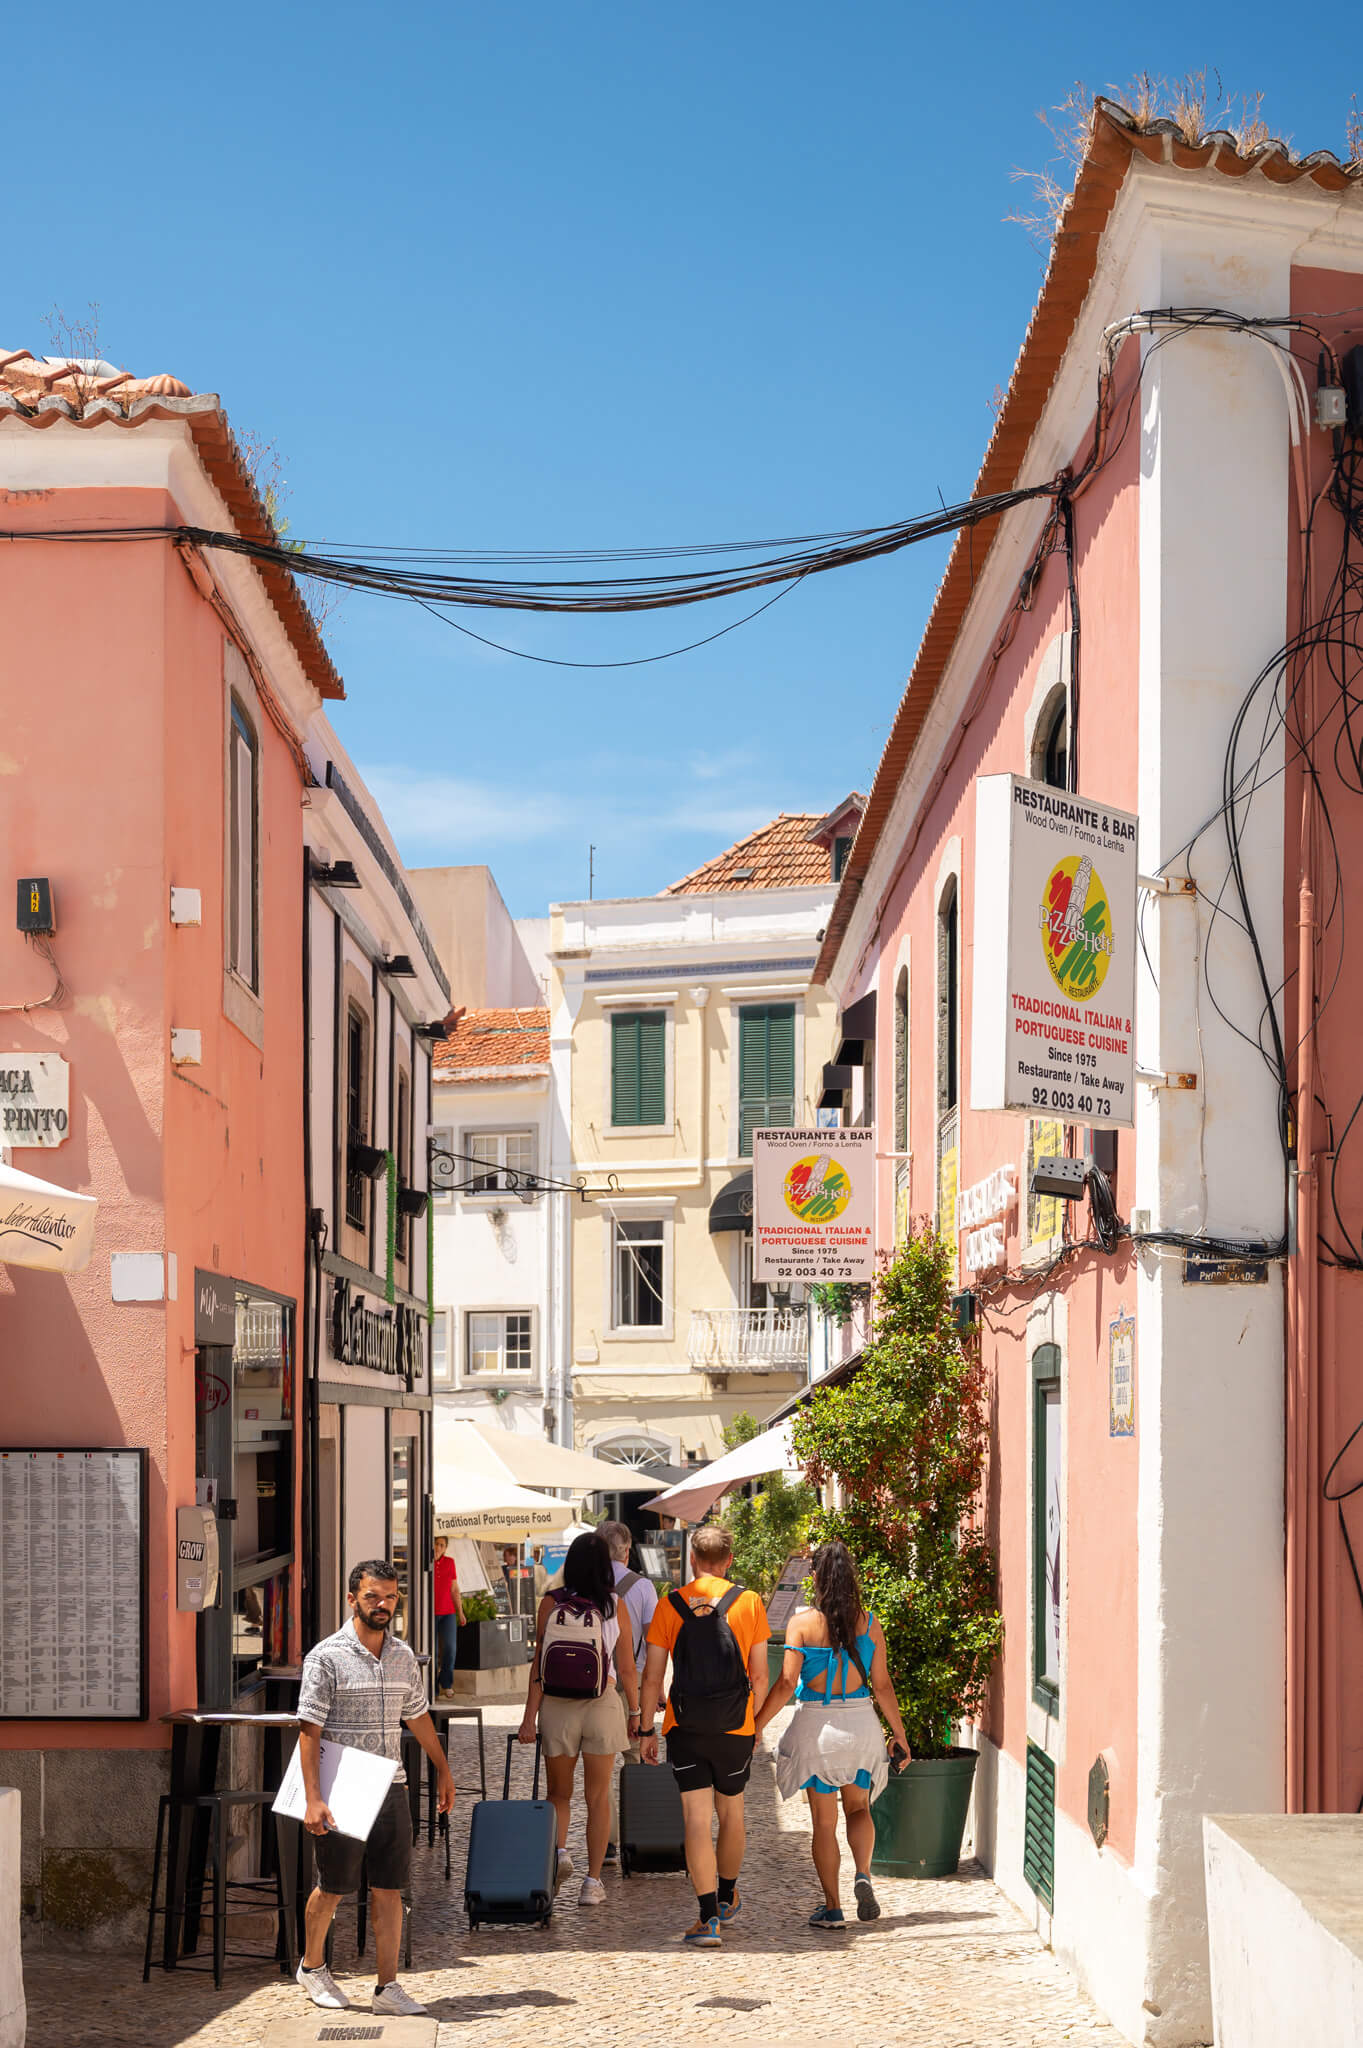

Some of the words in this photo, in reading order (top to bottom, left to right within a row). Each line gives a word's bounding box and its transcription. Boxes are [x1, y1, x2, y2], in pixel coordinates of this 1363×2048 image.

[1014, 786, 1098, 829] RESTAURANTE
[1102, 816, 1109, 833] &
[1113, 820, 1135, 841] BAR
[1025, 810, 1046, 828] Wood
[1049, 818, 1068, 835] Oven
[1074, 826, 1095, 844] Forno
[1097, 838, 1102, 846] a
[1104, 835, 1125, 853] Lenha
[1012, 993, 1081, 1023] TRADICIONAL
[1085, 1010, 1122, 1031] ITALIAN
[1125, 1019, 1132, 1033] &
[1015, 1018, 1085, 1046] PORTUGUESE
[1088, 1034, 1128, 1054] CUISINE
[1048, 1047, 1072, 1063] Since
[1076, 1052, 1097, 1068] 1975
[1018, 1061, 1072, 1083] Restaurante
[1081, 1072, 1100, 1088] Take
[1102, 1077, 1125, 1095] Away
[1032, 1087, 1048, 1105] 92
[1052, 1090, 1074, 1109] 003
[1078, 1095, 1092, 1113] 40
[1097, 1098, 1111, 1116] 73
[3, 1108, 68, 1131] PINTO
[757, 1131, 836, 1140] RESTAURANTE
[839, 1131, 846, 1140] &
[850, 1131, 873, 1140] BAR
[778, 1268, 792, 1276] 92
[796, 1268, 816, 1276] 003
[820, 1268, 834, 1276] 40
[838, 1268, 852, 1276] 73
[436, 1514, 480, 1529] Traditional
[483, 1513, 530, 1526] Portuguese
[532, 1512, 552, 1522] Food
[180, 1542, 203, 1560] GROW
